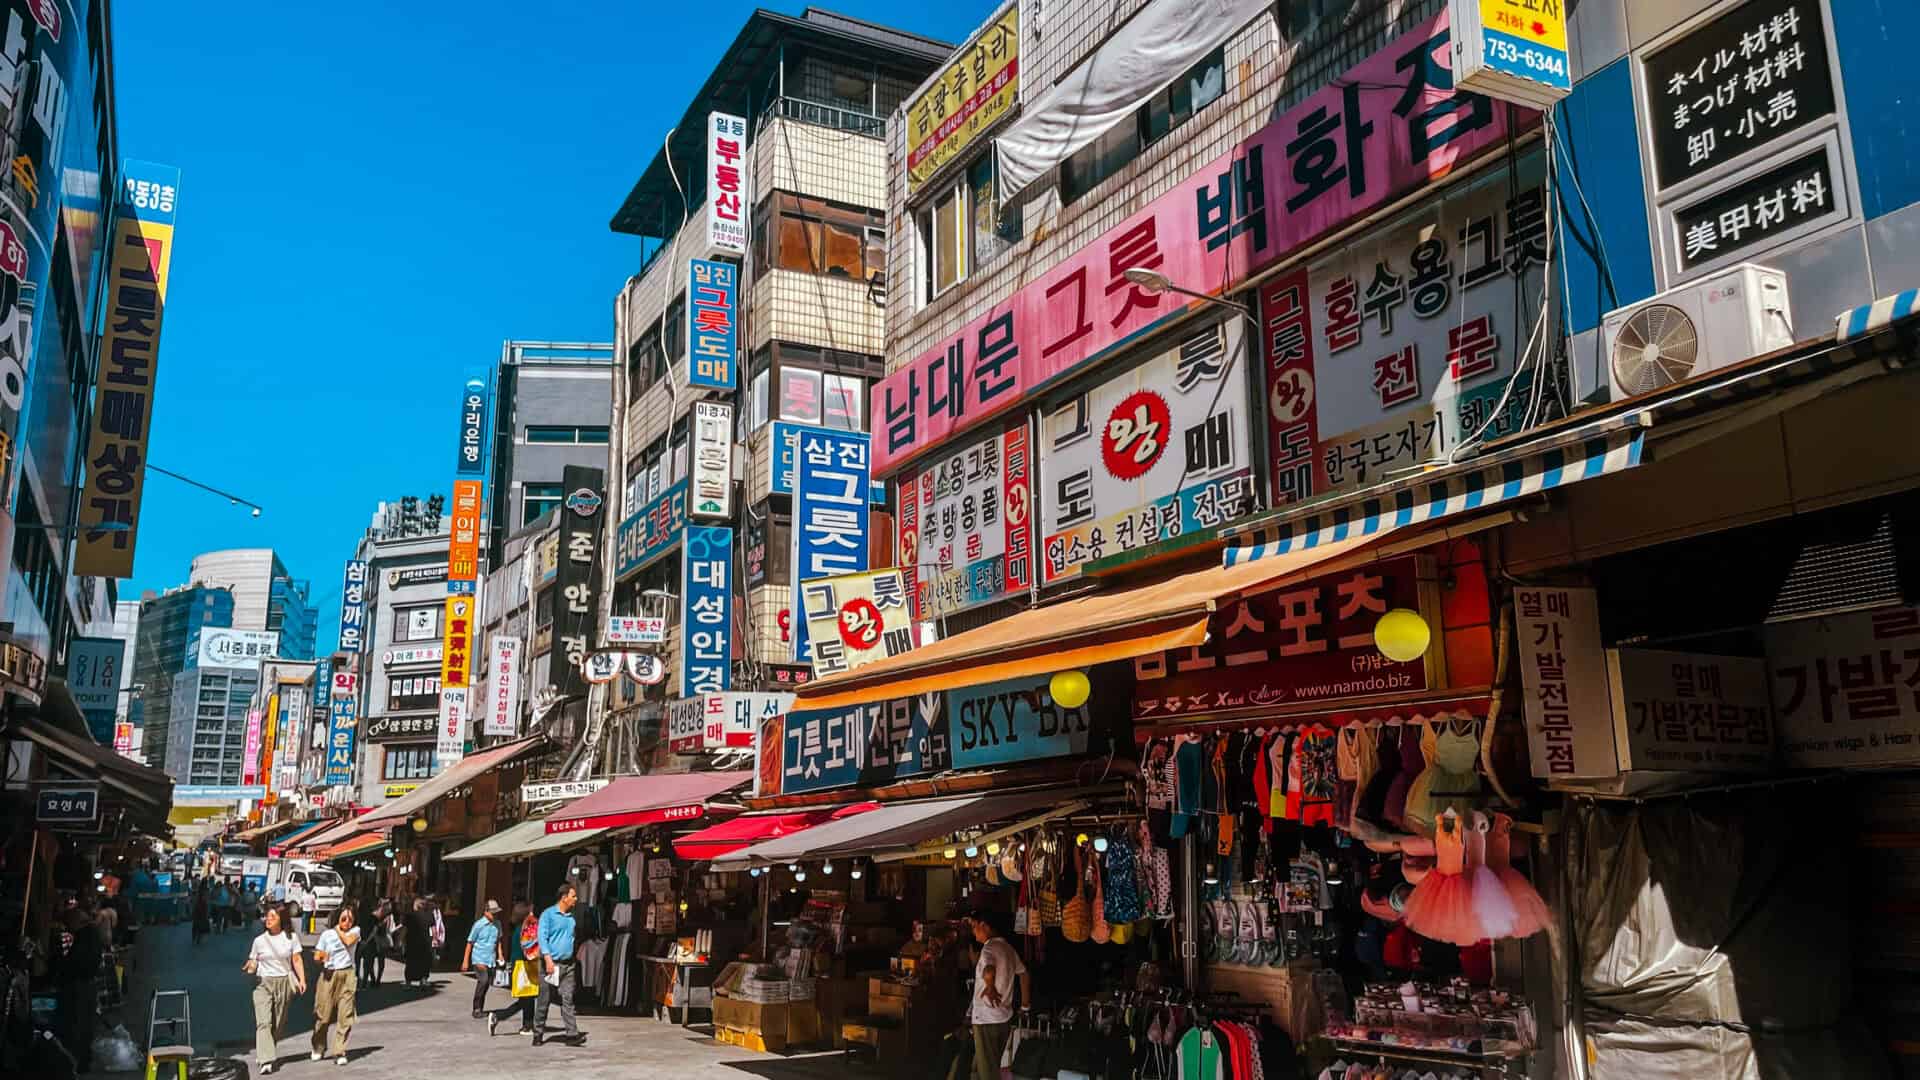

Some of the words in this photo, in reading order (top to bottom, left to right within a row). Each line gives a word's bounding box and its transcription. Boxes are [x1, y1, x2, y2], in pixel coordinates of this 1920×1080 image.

[1496, 10, 1524, 31] 지하
[1667, 7, 1800, 95] ネイル材料
[1487, 37, 1565, 78] 753-6344
[1673, 41, 1806, 130] まつげ材料
[716, 117, 744, 137] 일동
[1687, 89, 1798, 168] 卸・小売
[714, 137, 741, 223] 부동산
[1685, 171, 1827, 260] 美甲材料
[0, 230, 24, 273] 하
[693, 263, 732, 287] 일진
[694, 286, 732, 384] 그릇도매
[885, 310, 1018, 455] 남대문
[1042, 215, 1164, 360] 그릇
[1269, 286, 1305, 368] 그릇
[86, 234, 163, 550] 그릇도매상가
[1373, 314, 1497, 408] 전문
[463, 395, 484, 462] 우리은행
[803, 437, 866, 470] 삼진
[1323, 411, 1445, 485] 한국도자기
[1278, 424, 1312, 501] 도매
[1008, 527, 1028, 586] 도매
[1049, 527, 1107, 573] 업소용
[1115, 498, 1182, 550] 컨설팅
[1192, 477, 1243, 527] 전문
[453, 548, 472, 576] 도매
[561, 531, 594, 666] 준안경
[622, 619, 662, 632] 부동산
[690, 560, 727, 694] 대성안경
[1518, 591, 1571, 618] 열매
[335, 673, 356, 692] 약
[1294, 672, 1412, 699] www.namdo.biz
[1532, 623, 1576, 775] 가발전문점
[706, 697, 724, 741] 도매
[919, 734, 946, 769] 입구
[960, 691, 1019, 752] SKY
[1631, 699, 1770, 745] 가발전문점
